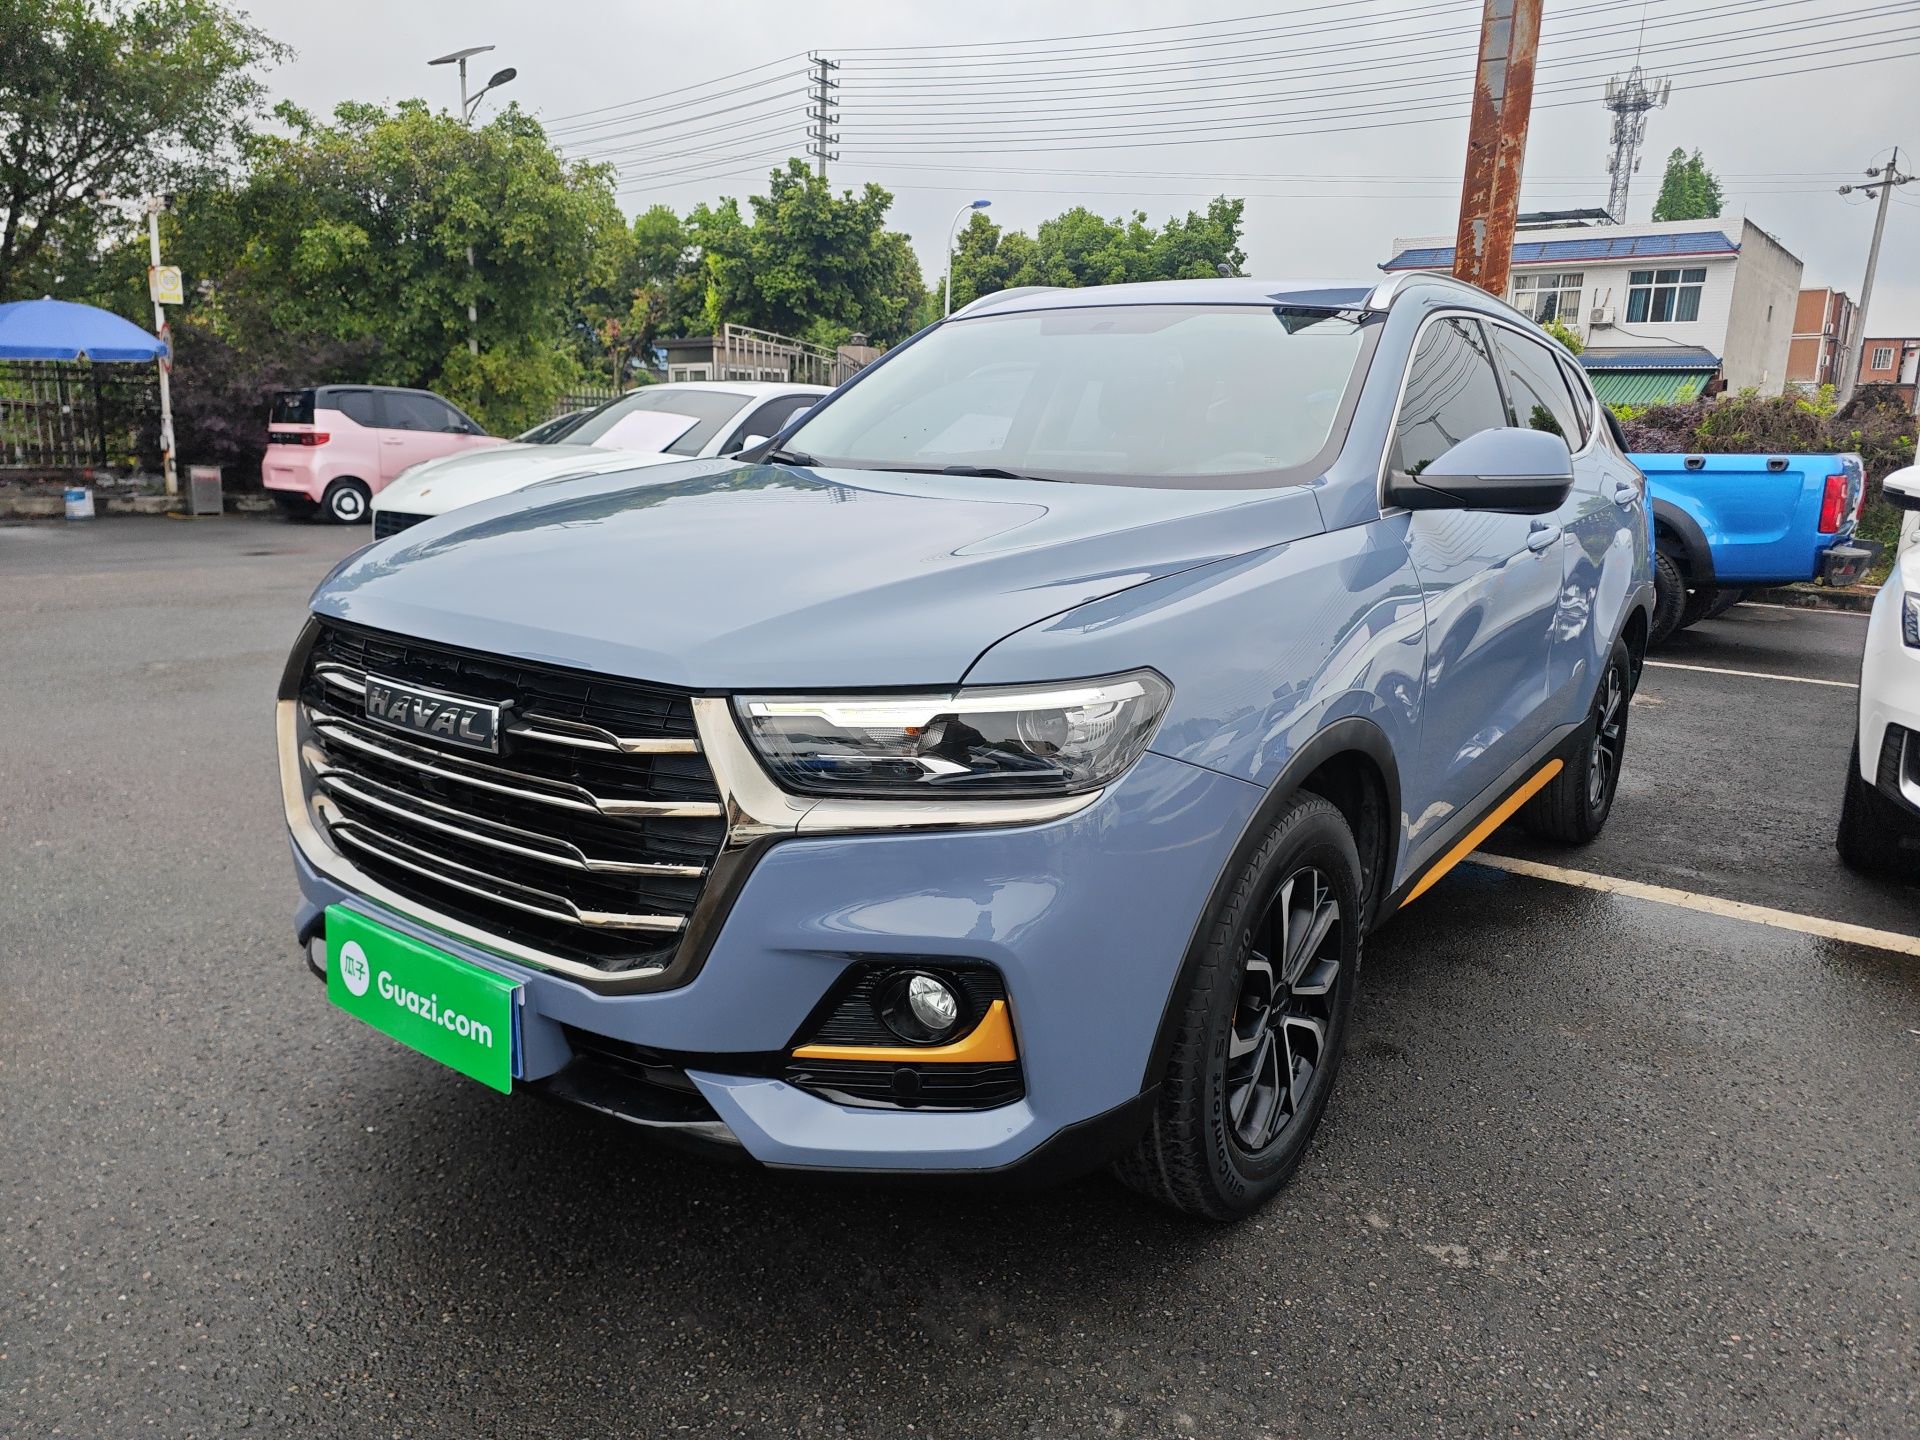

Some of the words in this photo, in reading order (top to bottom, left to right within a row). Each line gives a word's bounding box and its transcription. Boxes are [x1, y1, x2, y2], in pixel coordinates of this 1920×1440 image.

[368, 686, 486, 742] HAVAL
[344, 955, 366, 981] 瓜子
[377, 970, 493, 1049] Guazi.com
